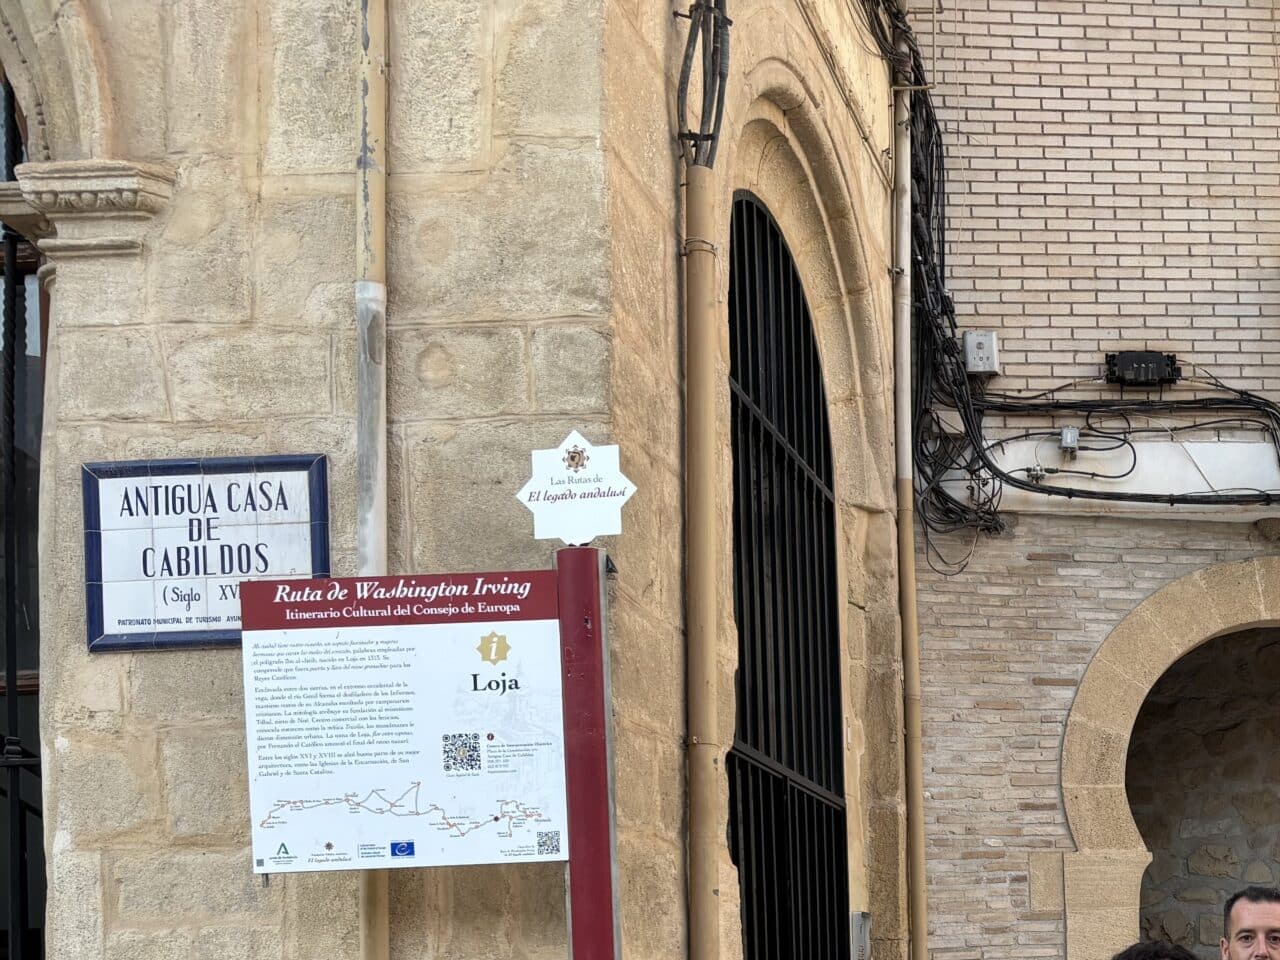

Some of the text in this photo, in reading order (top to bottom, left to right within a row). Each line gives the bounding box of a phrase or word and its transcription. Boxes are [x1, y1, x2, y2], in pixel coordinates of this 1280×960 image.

[550, 474, 603, 486] Las Rutas de
[120, 480, 289, 517] ANTIGUA CASA
[528, 486, 627, 504] El legado andalusí
[188, 517, 221, 542] DE
[142, 543, 269, 577] CABILDOS
[219, 584, 240, 600] XV
[273, 577, 531, 603] Ruta de Washington Irving
[286, 602, 520, 620] Itinerario Cultural del Consejo de Europa
[471, 672, 520, 696] Loja
